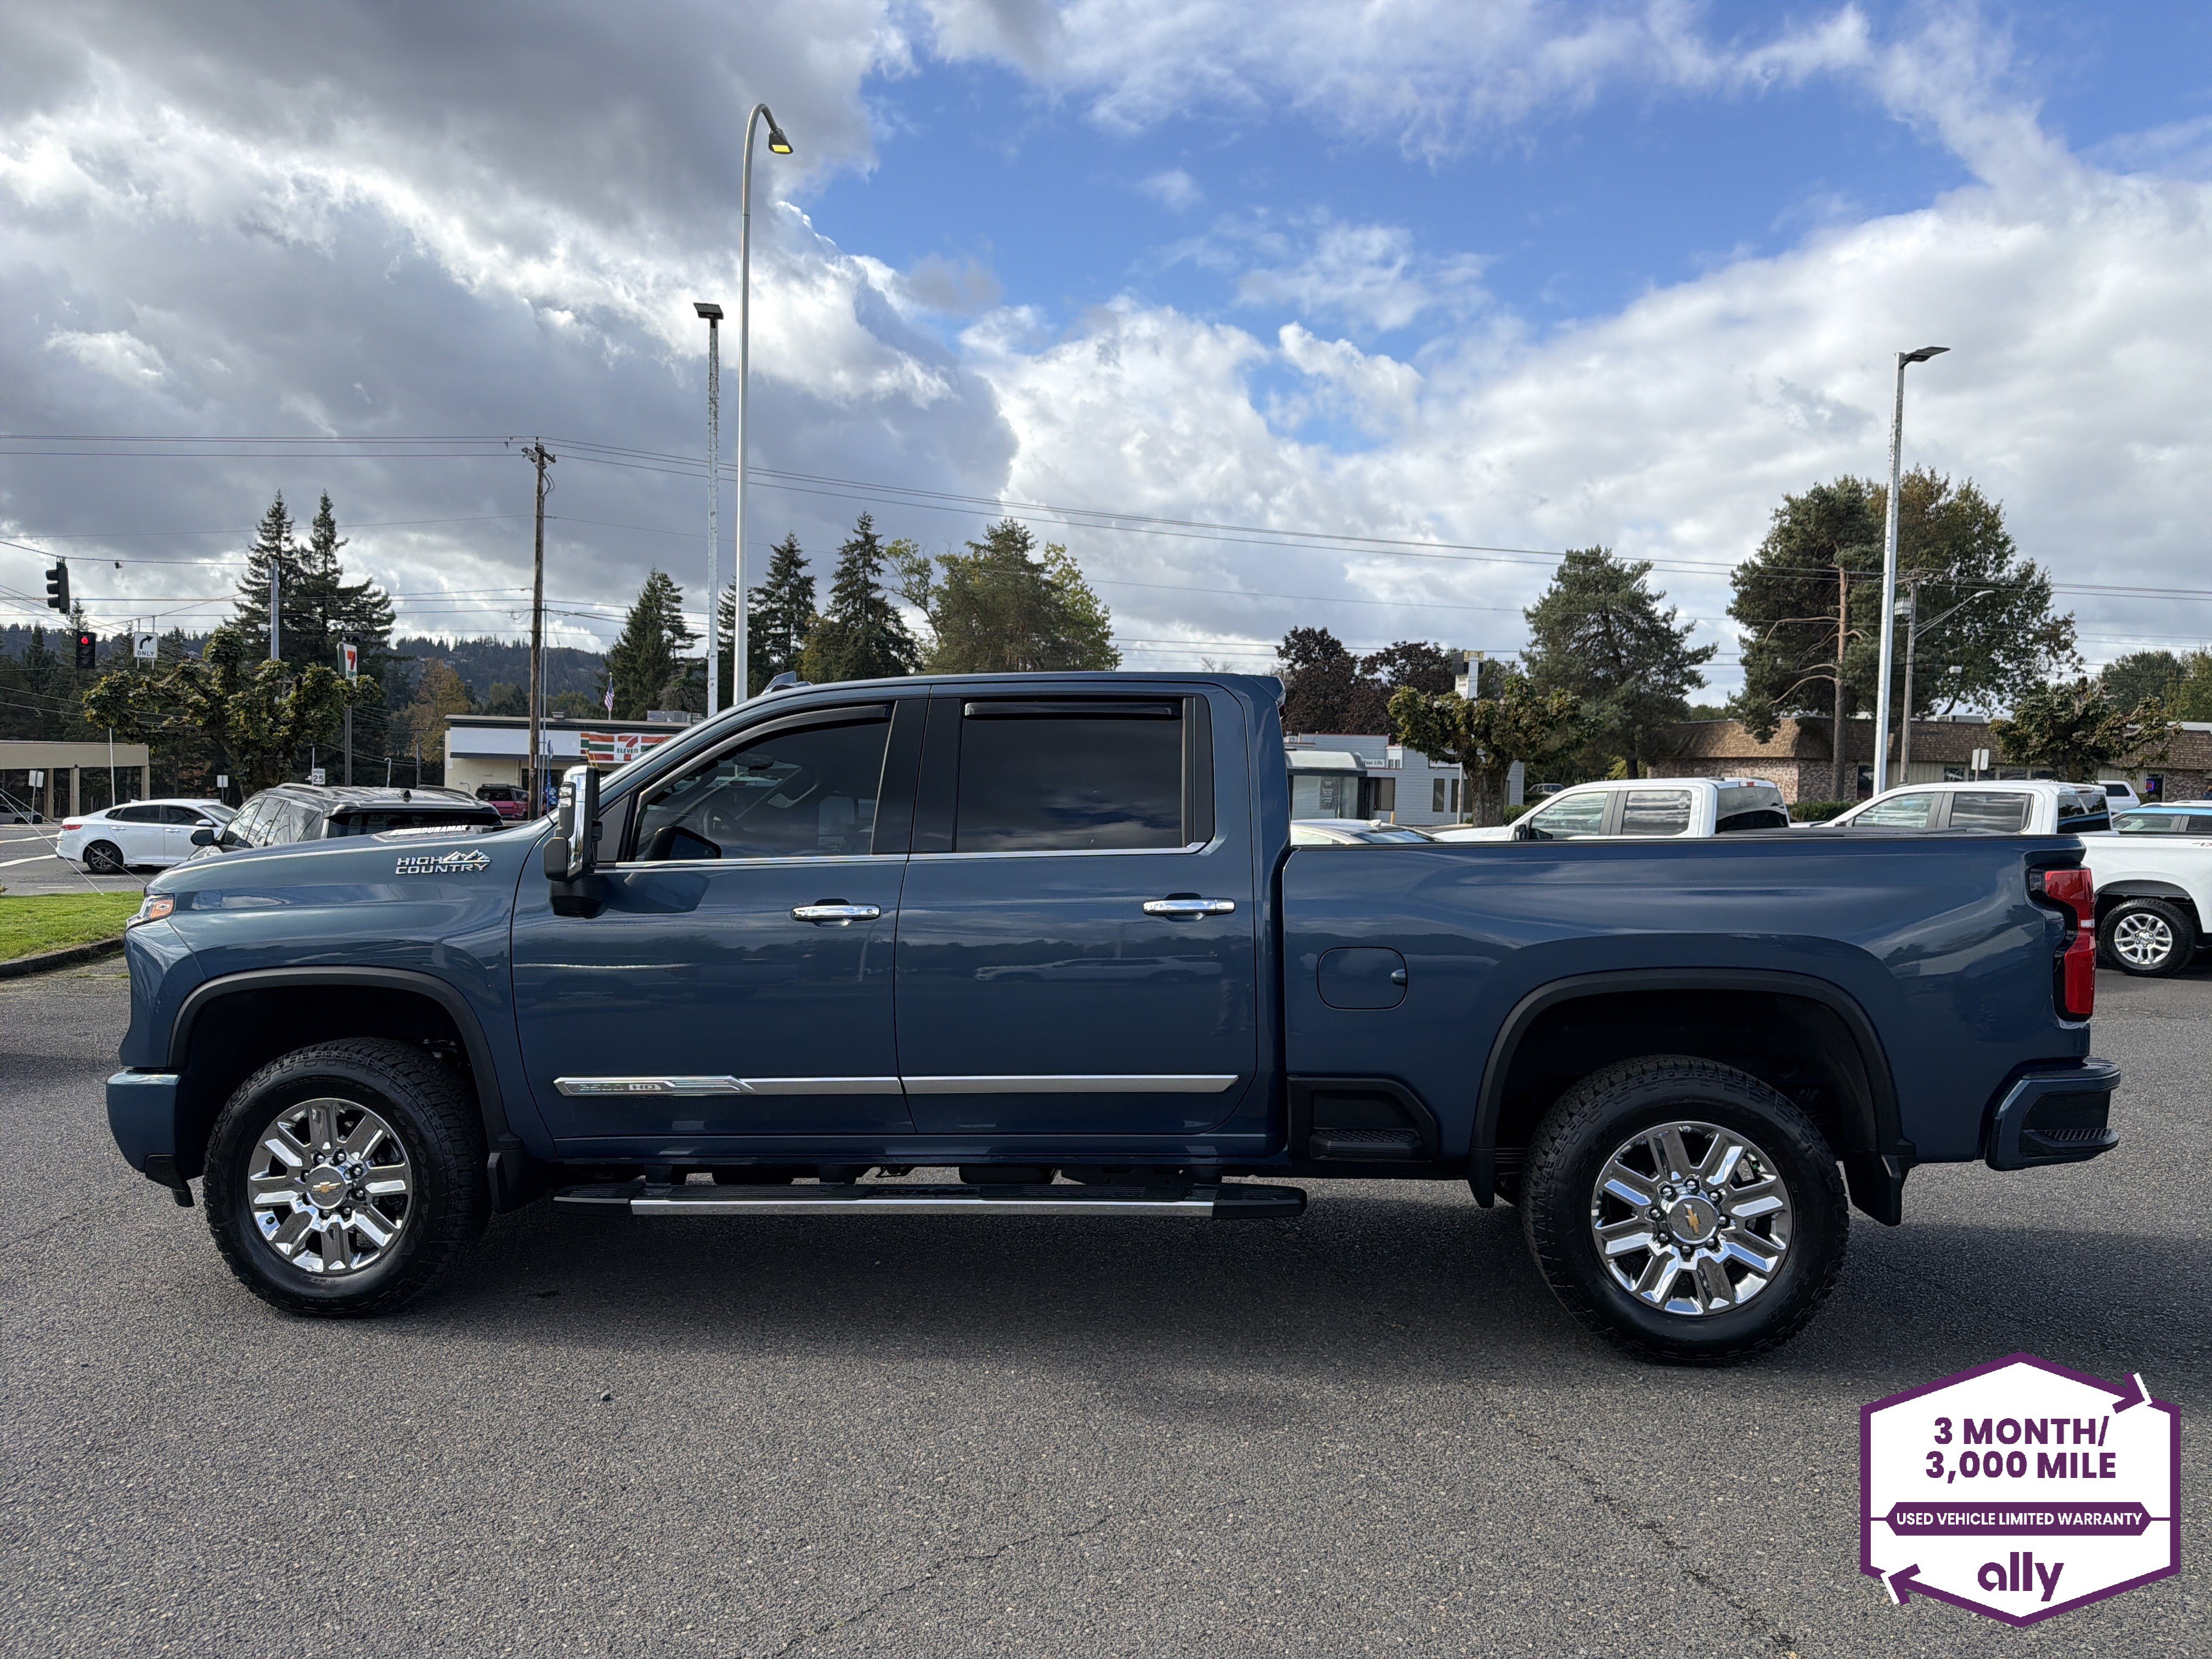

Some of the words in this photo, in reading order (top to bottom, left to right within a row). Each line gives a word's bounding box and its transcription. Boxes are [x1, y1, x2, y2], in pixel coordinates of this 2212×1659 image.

[347, 650, 356, 670] 7
[618, 736, 638, 761] 7
[420, 825, 468, 833] DURAMAX
[397, 856, 443, 866] HIGH
[395, 864, 489, 874] COUNTRY
